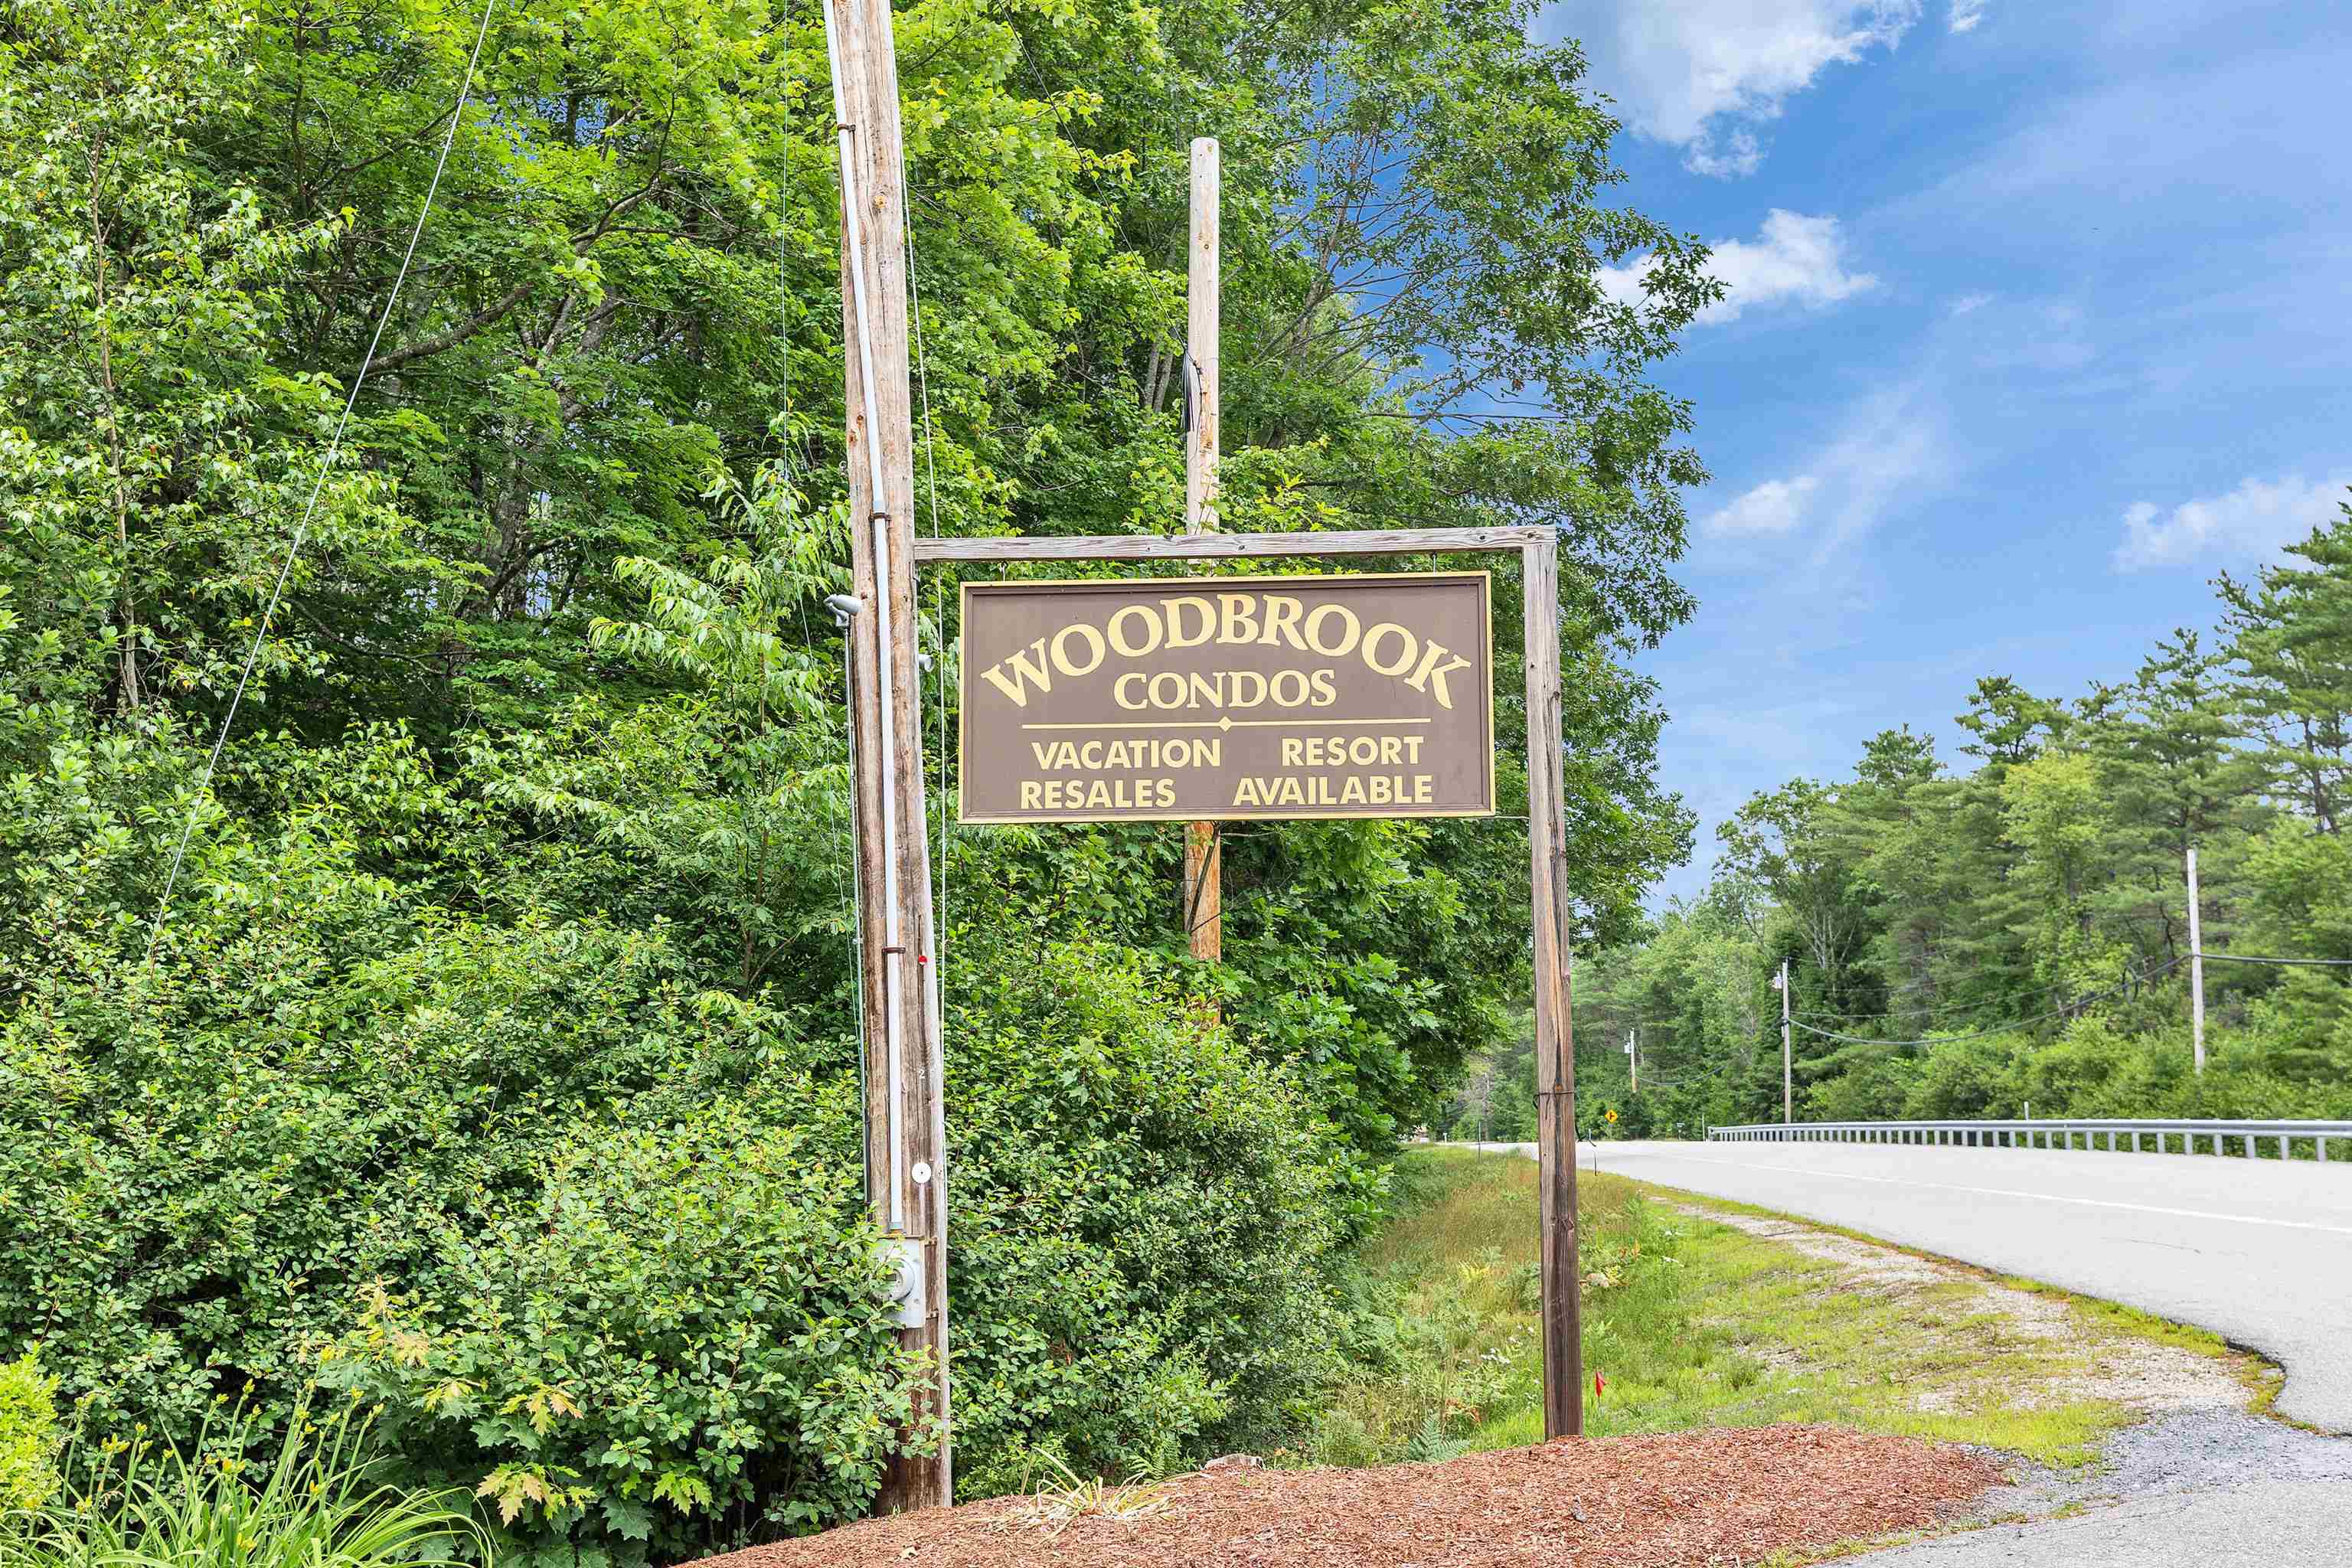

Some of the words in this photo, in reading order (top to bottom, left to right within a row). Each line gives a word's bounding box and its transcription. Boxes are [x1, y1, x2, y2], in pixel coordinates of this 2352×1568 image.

[981, 594, 1472, 710] WOODBROOK
[1114, 670, 1337, 710] CONDOS
[1031, 739, 1220, 770] VACATION
[1282, 736, 1424, 766] RESORT
[1021, 779, 1176, 809] RESALES
[1233, 775, 1432, 806] AVAILABLE
